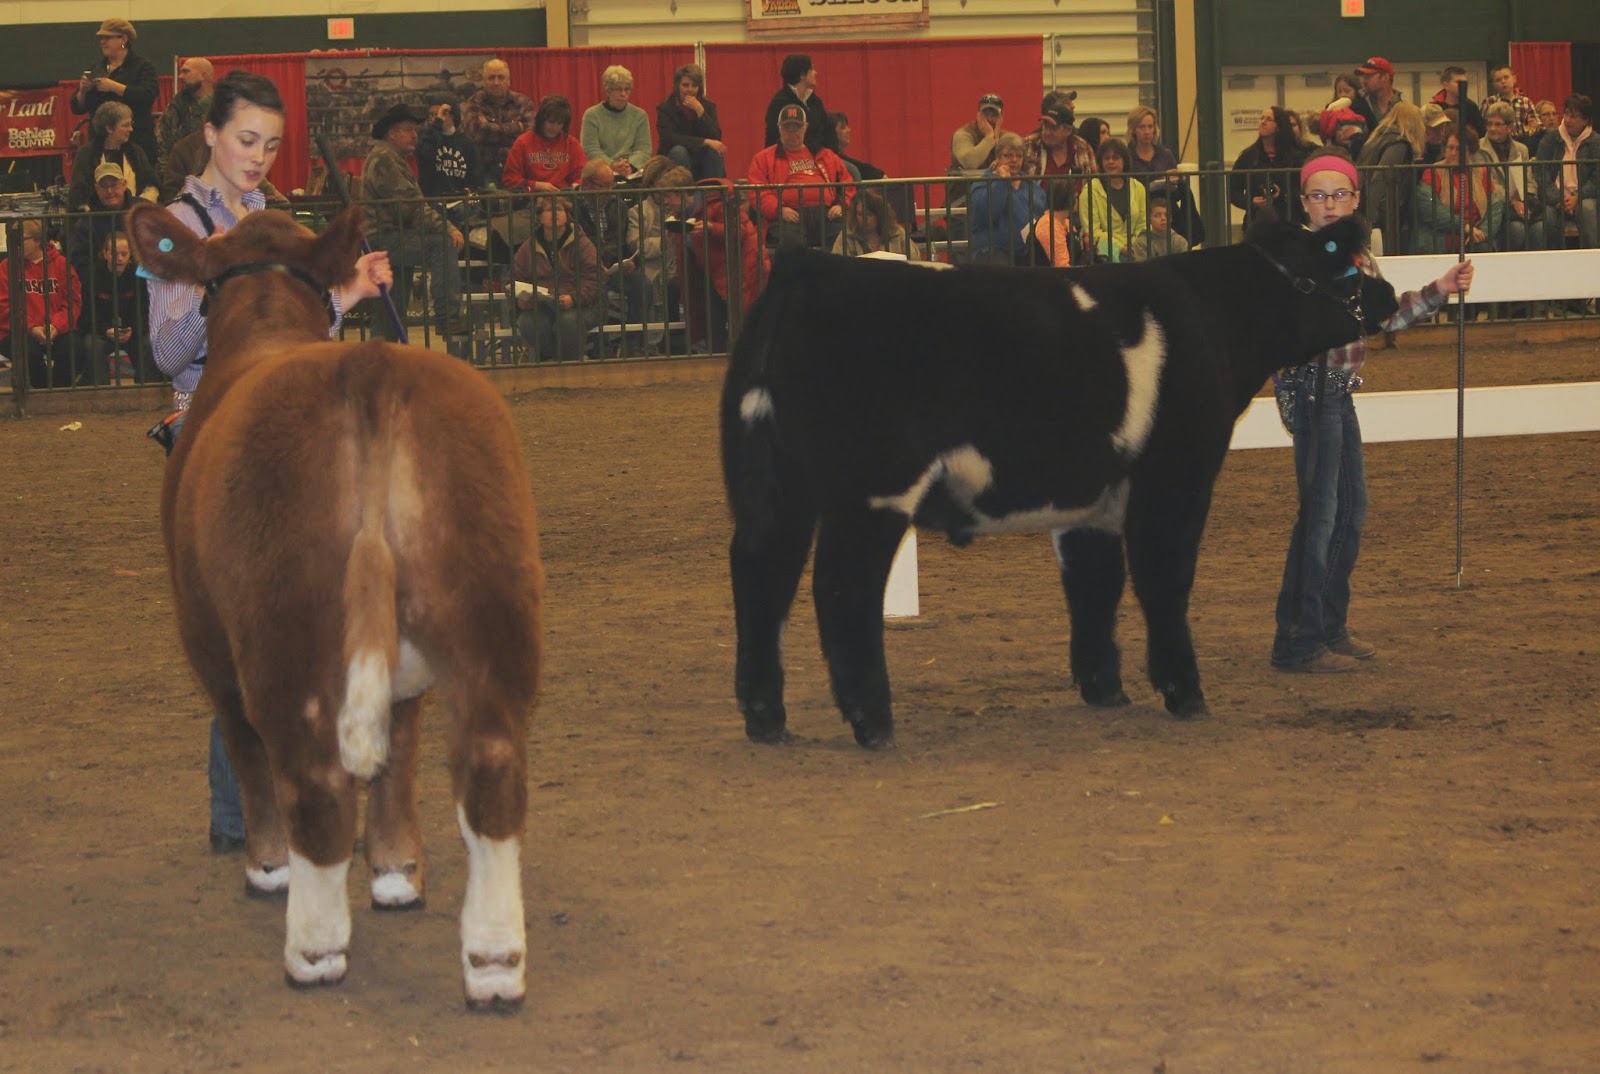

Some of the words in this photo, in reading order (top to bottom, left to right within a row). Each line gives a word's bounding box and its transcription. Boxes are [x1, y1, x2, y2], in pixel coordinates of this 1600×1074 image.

[7, 95, 57, 117] Land
[8, 127, 55, 140] Behlen
[8, 138, 55, 148] COUNTRY
